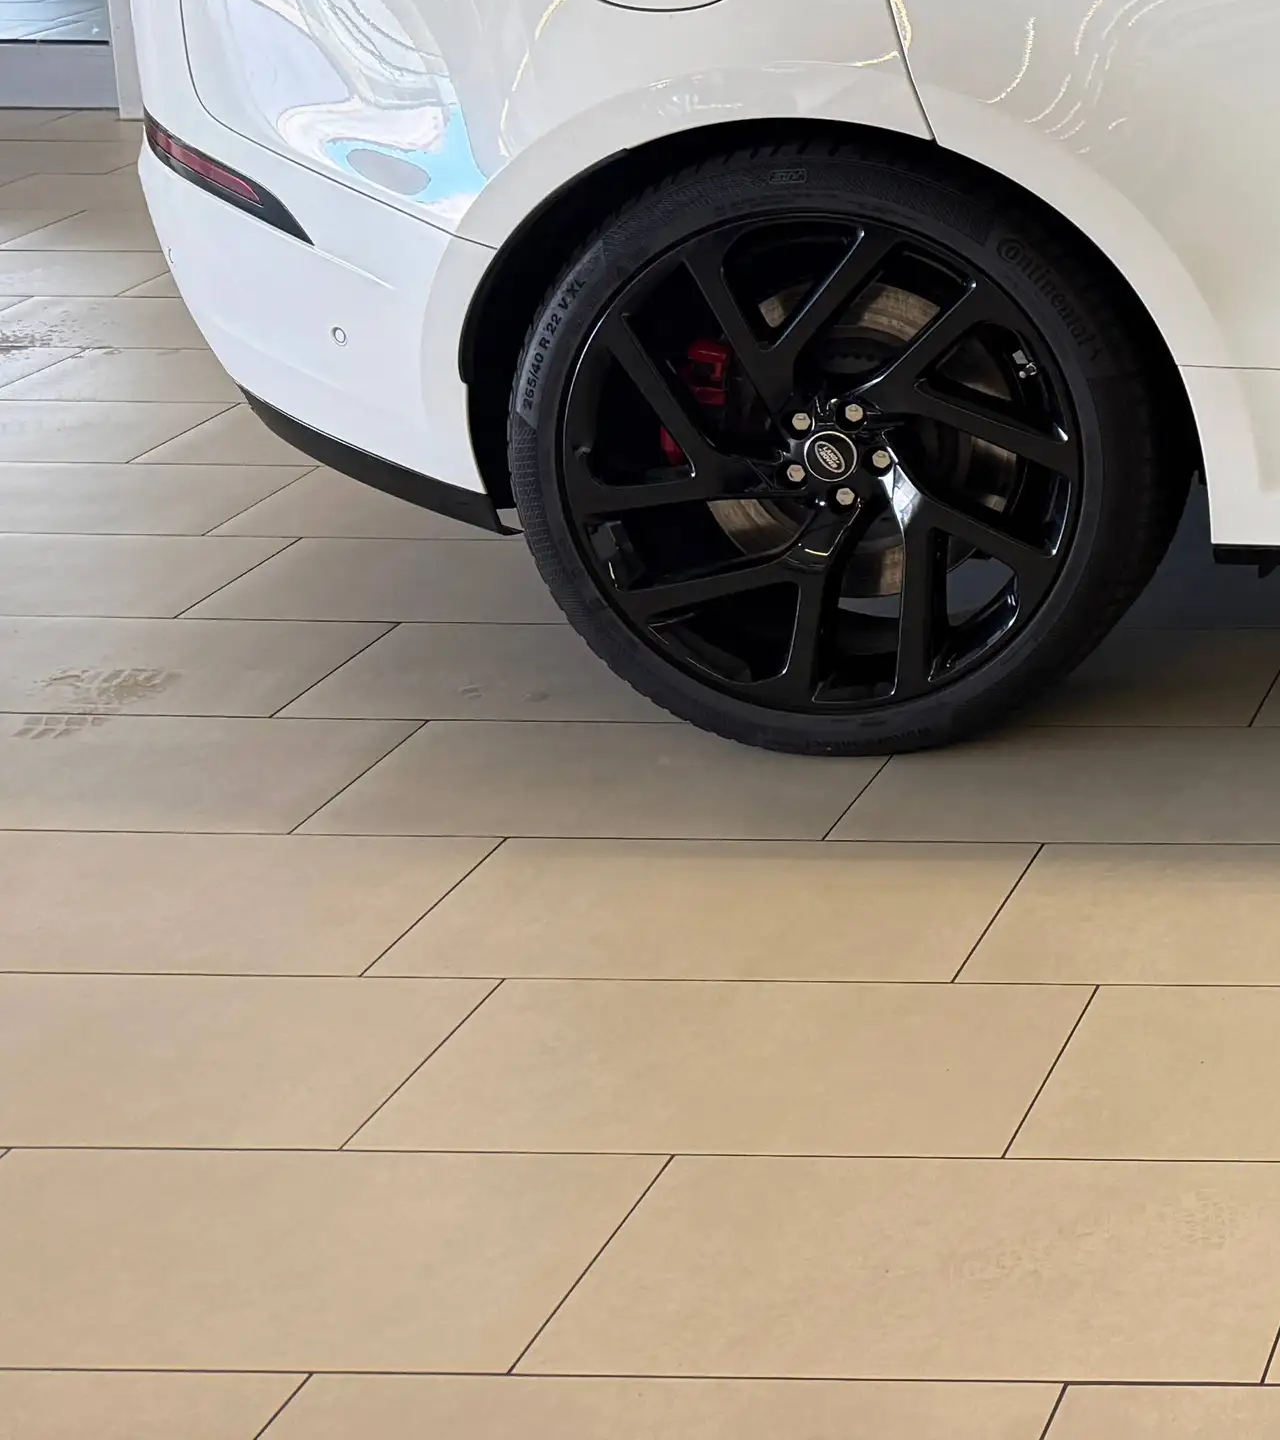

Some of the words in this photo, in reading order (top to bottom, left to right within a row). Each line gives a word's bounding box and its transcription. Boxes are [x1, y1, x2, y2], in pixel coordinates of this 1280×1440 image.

[996, 238, 1096, 347] Continental
[522, 353, 544, 410] 265/40
[539, 336, 550, 350] R
[546, 313, 562, 336] 22
